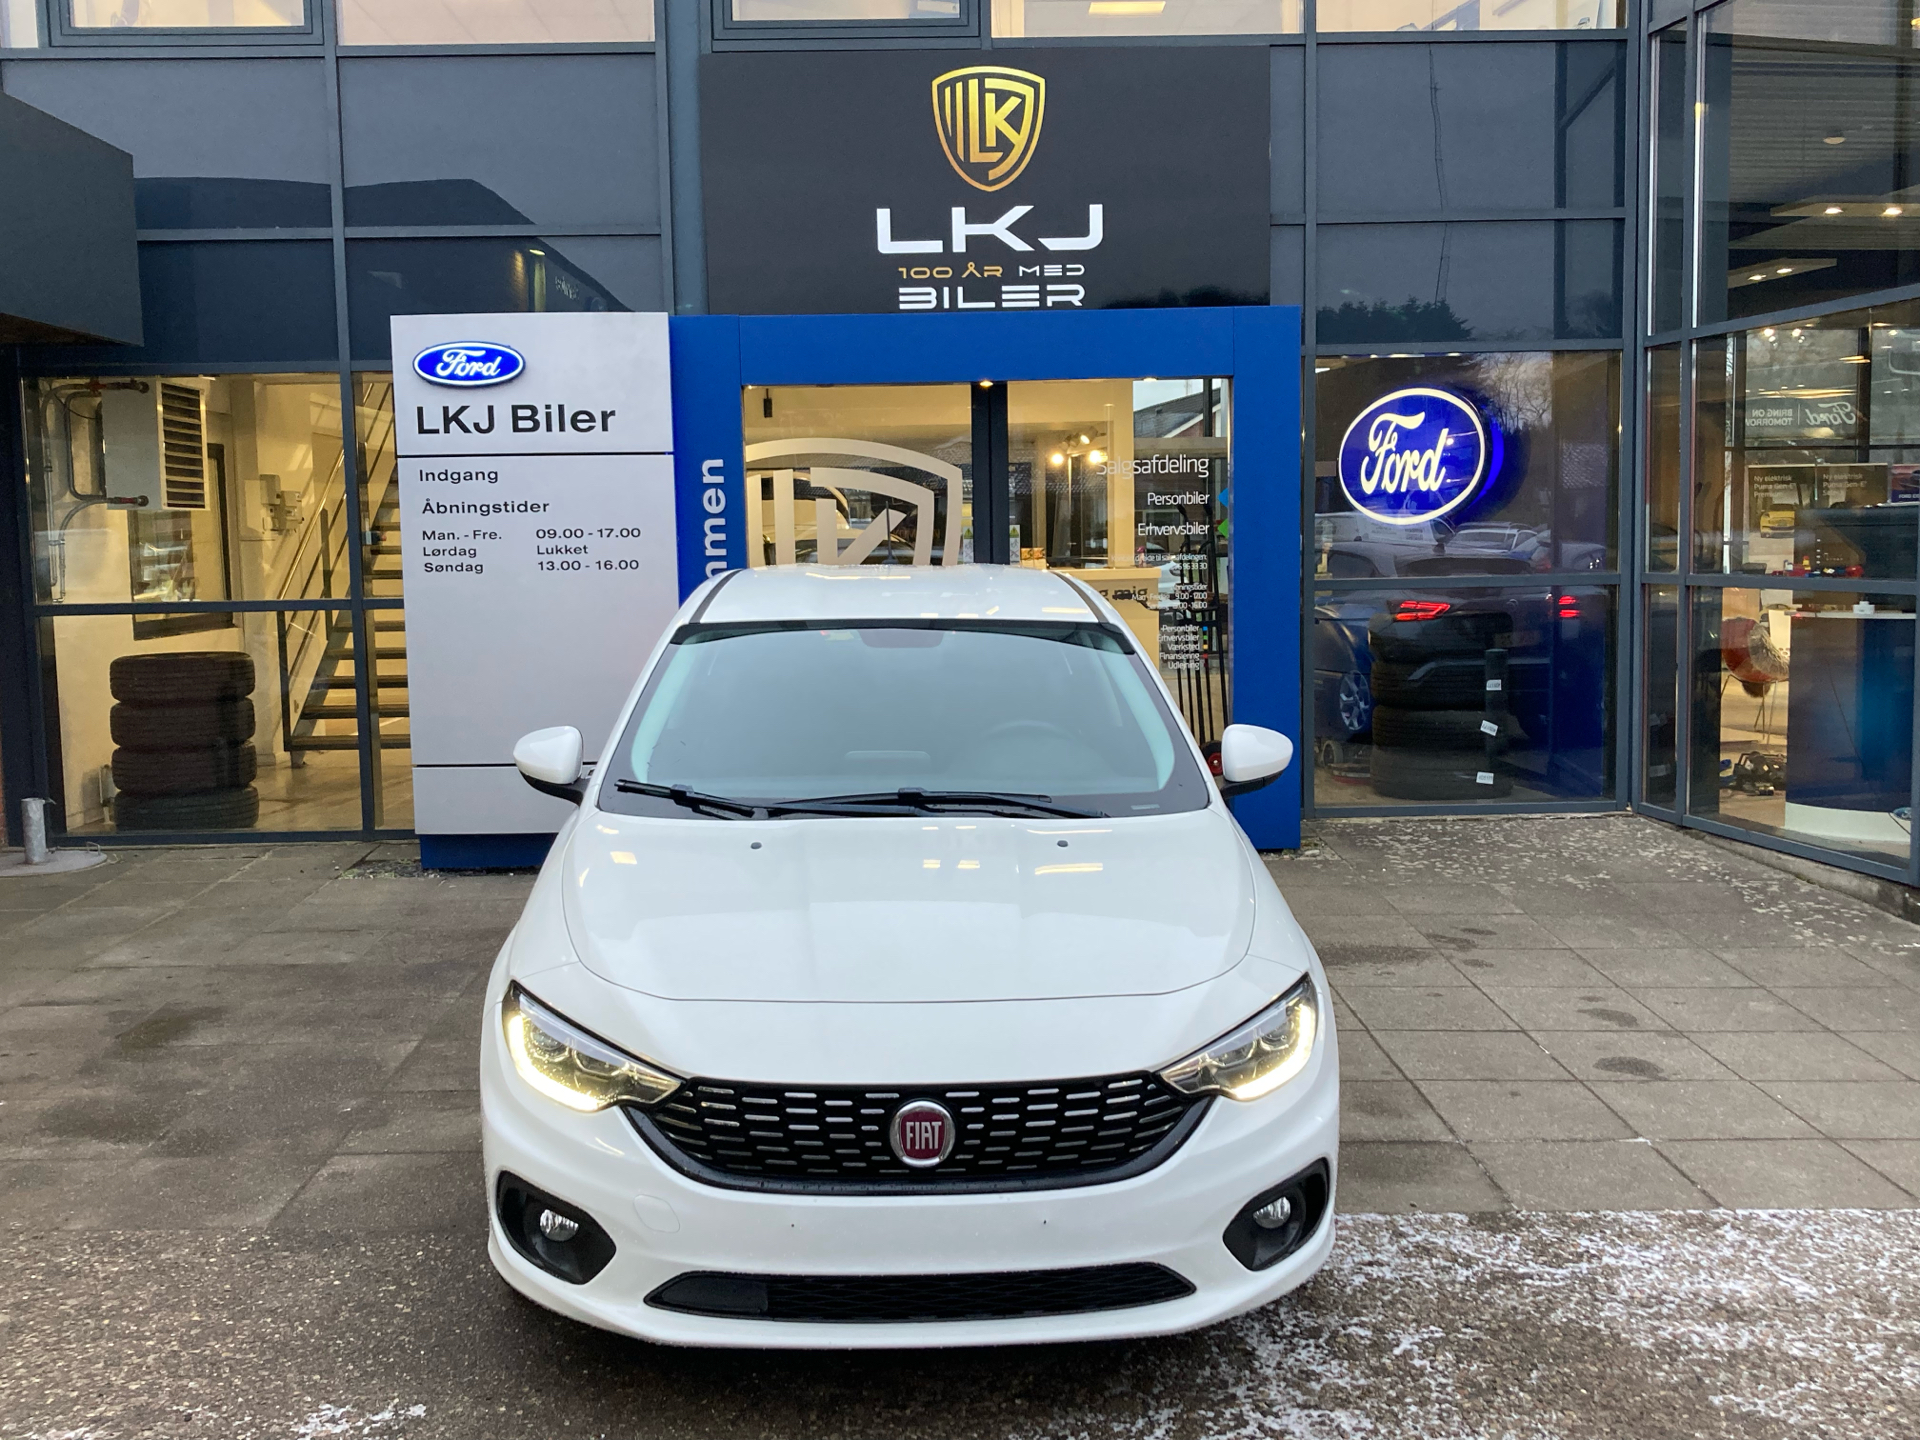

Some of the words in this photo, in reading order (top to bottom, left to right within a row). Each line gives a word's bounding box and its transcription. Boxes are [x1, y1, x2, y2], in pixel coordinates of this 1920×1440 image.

[877, 203, 1103, 254] LKJ
[898, 266, 953, 279] 100
[961, 261, 1003, 278] ÅR
[1018, 263, 1085, 277] MED
[898, 284, 1086, 310] BILER
[435, 348, 503, 377] Ford
[416, 404, 496, 435] LKJ
[511, 403, 616, 433] Biler
[1360, 411, 1449, 495] Ford
[1096, 454, 1209, 479] Salgsafdeling
[418, 468, 499, 485] Indgang
[421, 498, 550, 517] Åbningstider
[1147, 491, 1210, 506] Personbiler
[422, 530, 461, 541] Man.
[472, 529, 503, 541] Fre.
[535, 527, 585, 539] 09.00
[597, 527, 641, 539] 17.00
[1137, 521, 1210, 537] Erhvervsbiler
[422, 546, 478, 559] Lørdag
[536, 544, 589, 556] Lukket
[423, 561, 484, 574] Søndag
[537, 560, 582, 572] 13.00
[596, 559, 640, 571] 16.00
[905, 1121, 942, 1150] FIAT
